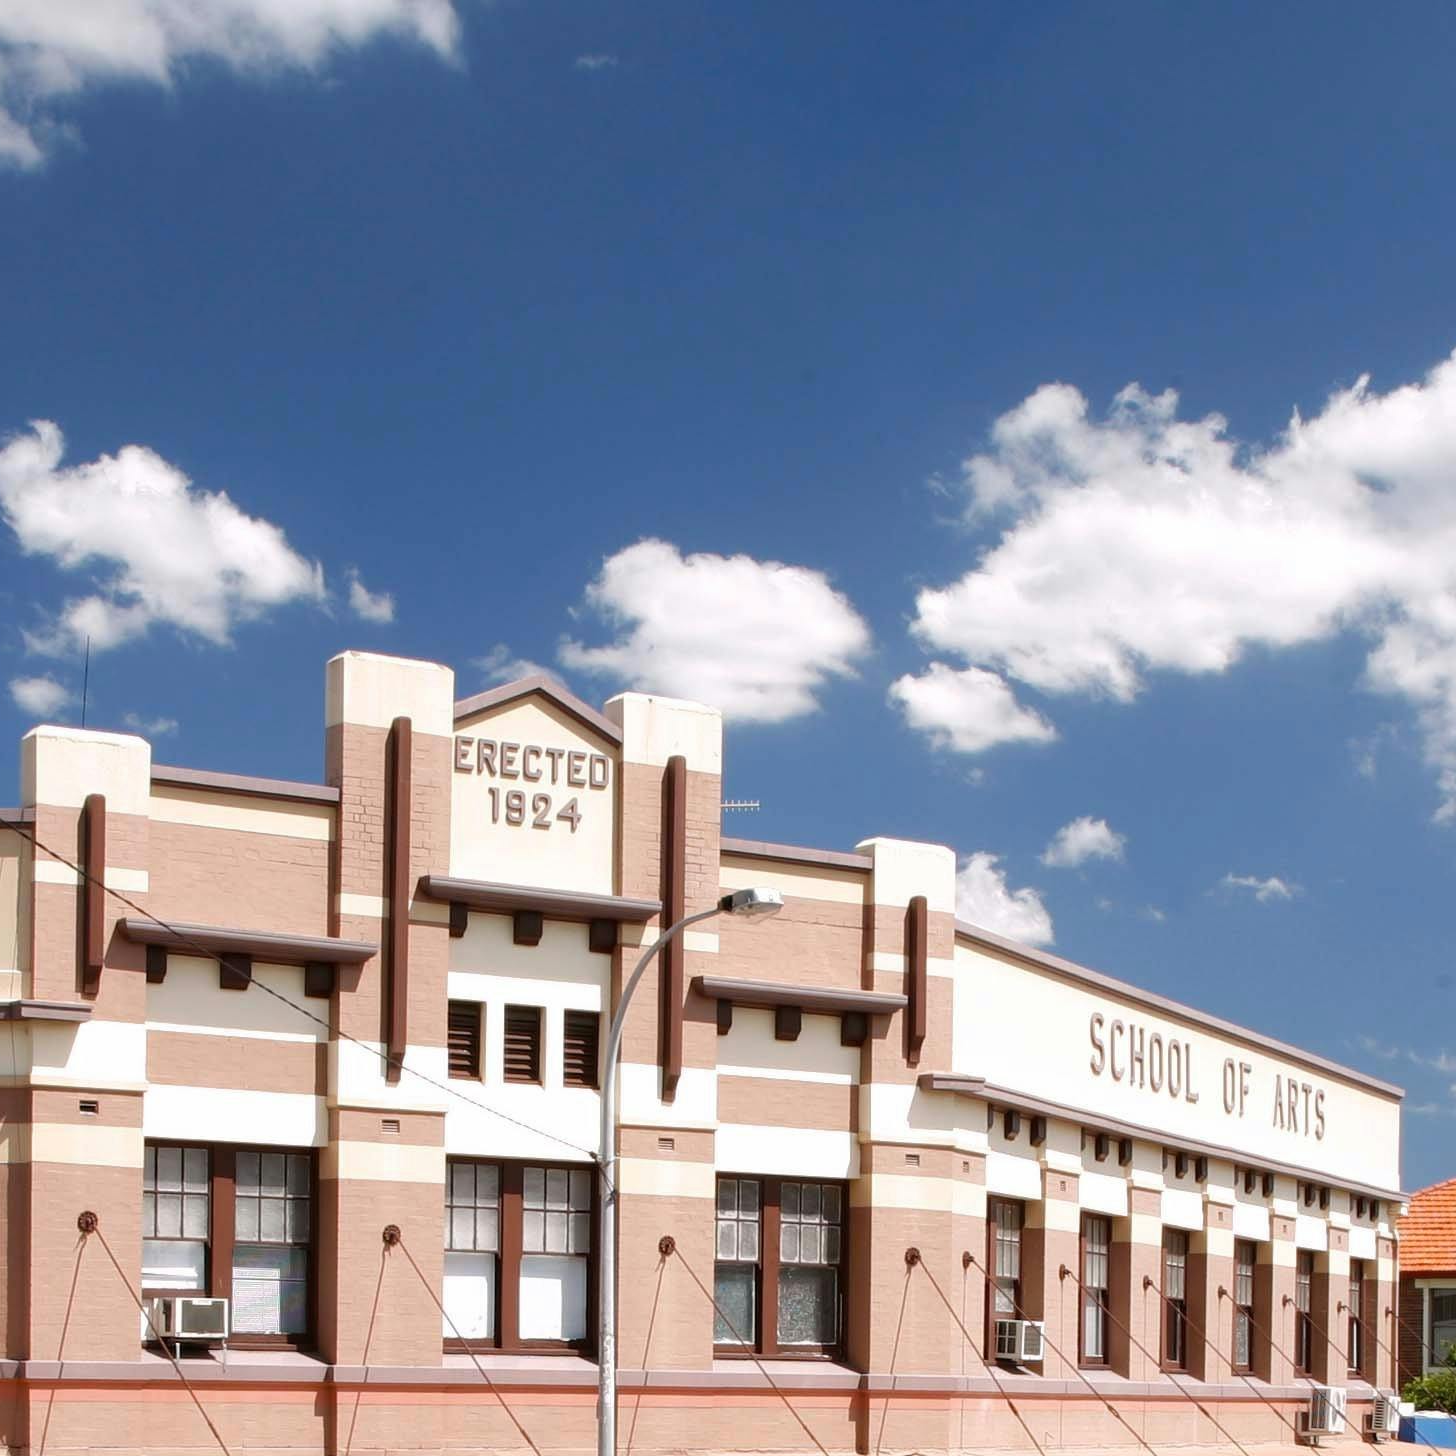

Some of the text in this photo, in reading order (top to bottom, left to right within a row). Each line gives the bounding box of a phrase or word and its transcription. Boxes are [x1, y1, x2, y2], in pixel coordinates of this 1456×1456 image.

[454, 734, 610, 791] ERECTED
[487, 786, 583, 834] 1924
[1089, 1011, 1326, 1142] SCHOOL OF ARTS
